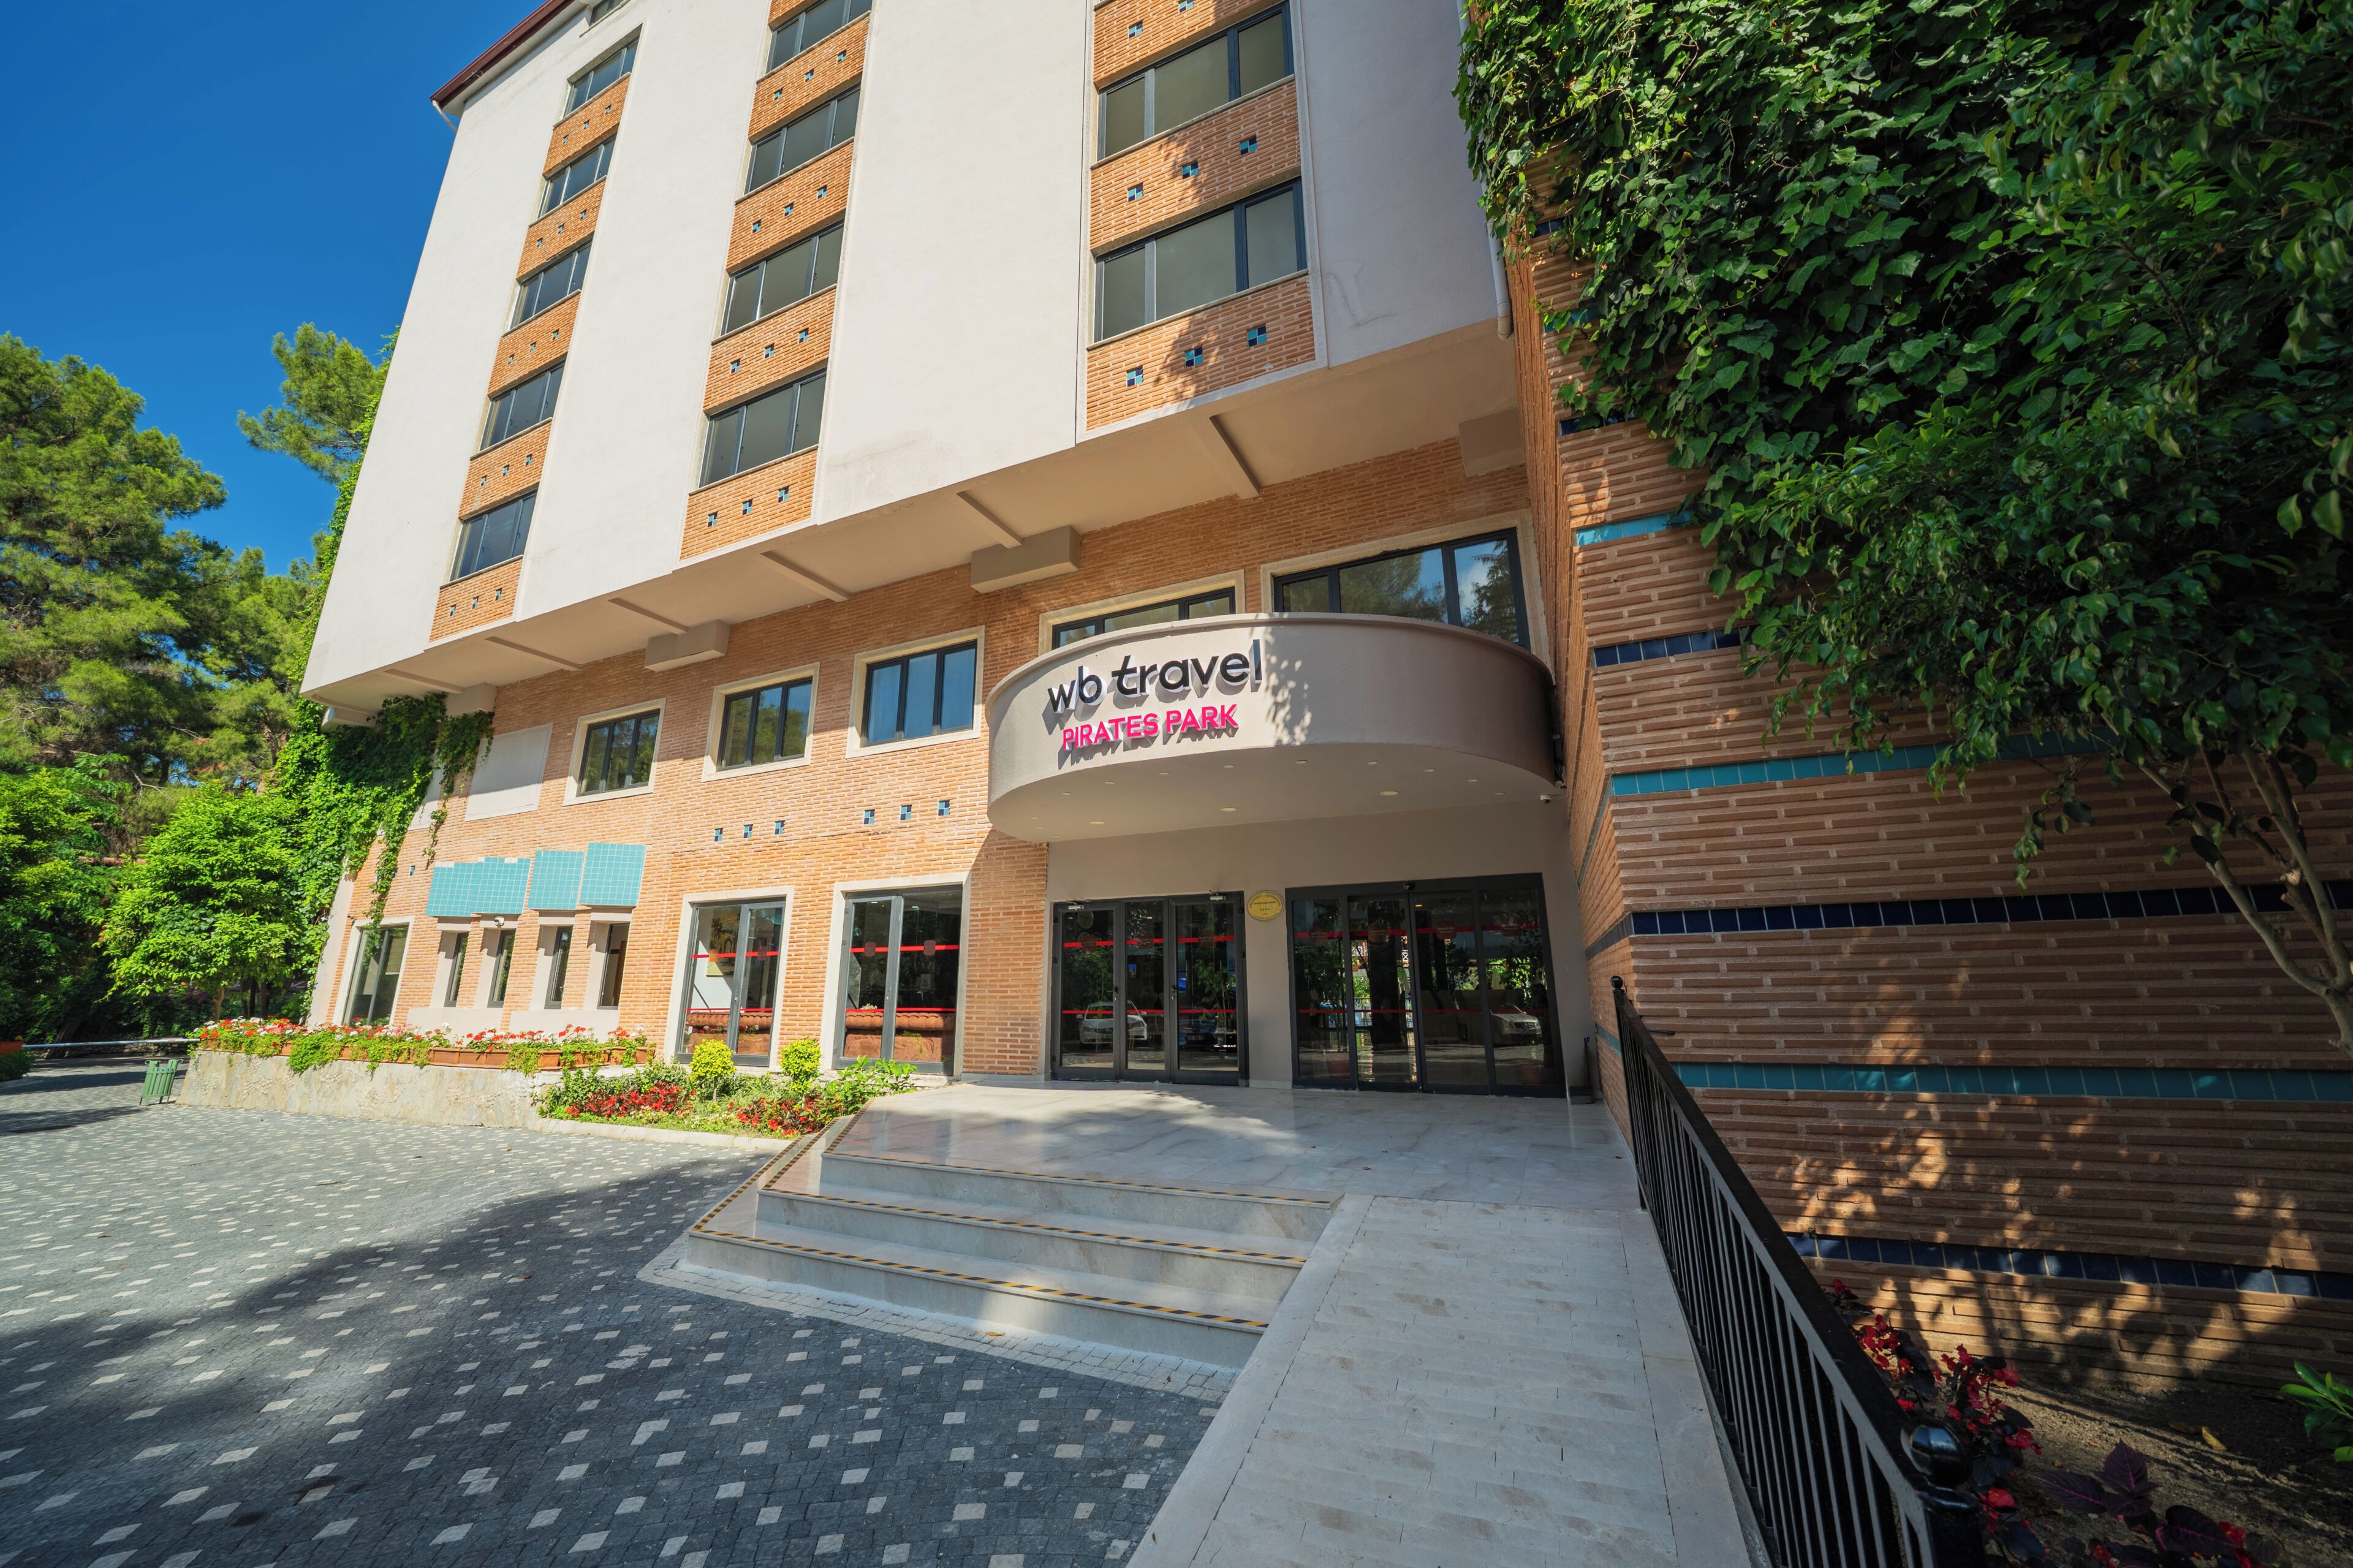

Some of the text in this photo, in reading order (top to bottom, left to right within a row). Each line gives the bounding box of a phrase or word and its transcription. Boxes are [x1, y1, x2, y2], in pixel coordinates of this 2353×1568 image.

[1047, 639, 1262, 712] wb travel
[1063, 704, 1239, 751] PIRATES PARK
